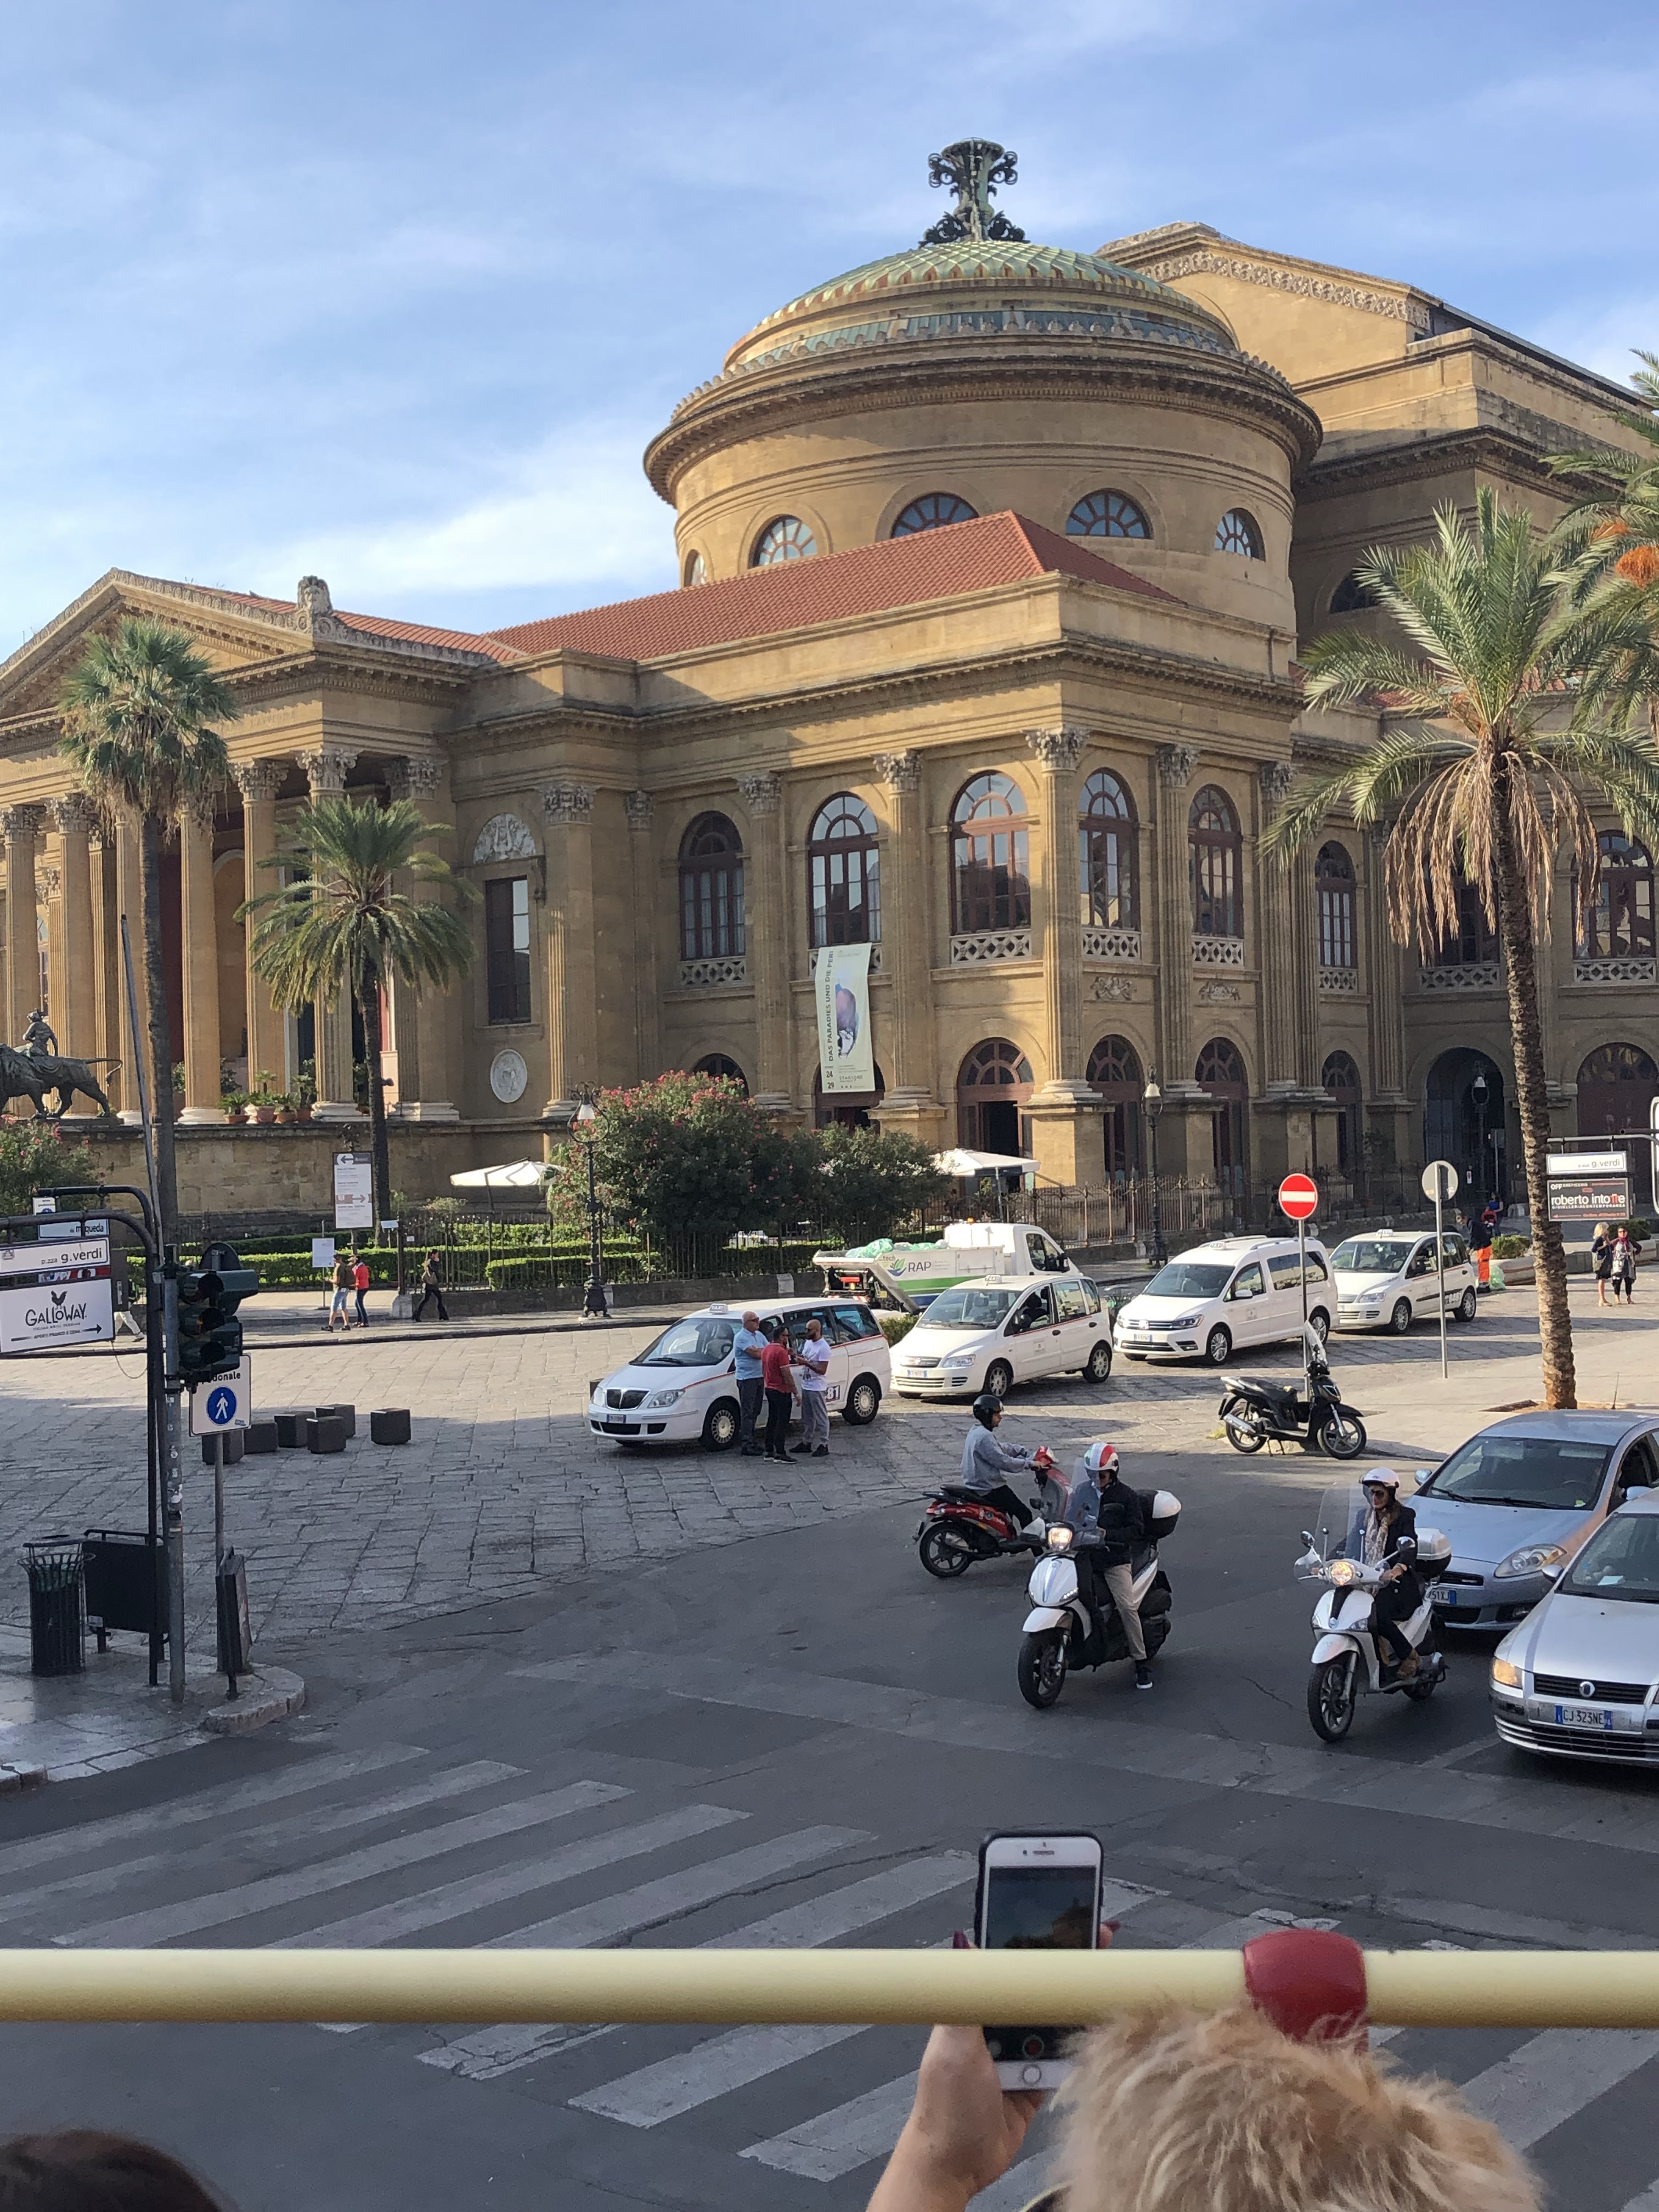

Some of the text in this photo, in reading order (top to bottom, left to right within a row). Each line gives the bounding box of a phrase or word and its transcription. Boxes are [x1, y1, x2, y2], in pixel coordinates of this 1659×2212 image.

[1591, 1159, 1621, 1169] g.verdi
[1551, 1194, 1589, 1205] roberto
[75, 1223, 104, 1234] mqueda
[41, 1247, 103, 1266] p.zza g.verdi
[908, 1261, 932, 1272] RAP
